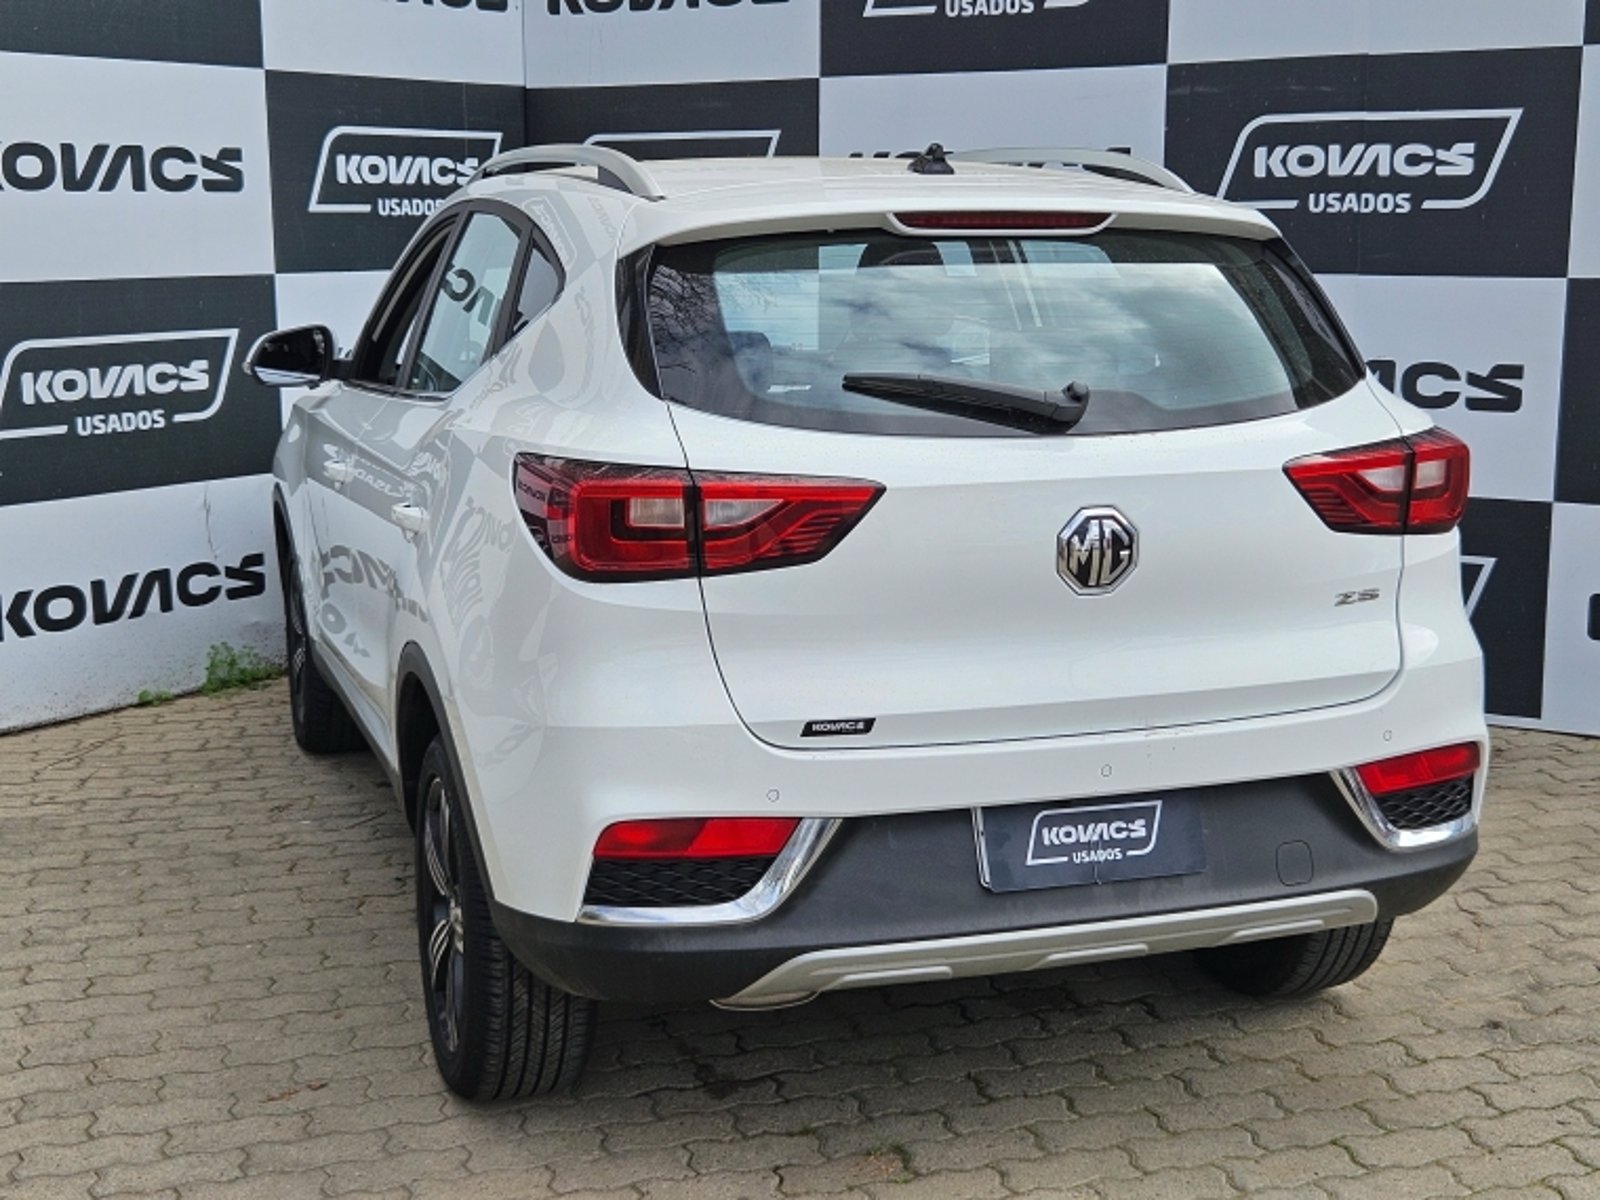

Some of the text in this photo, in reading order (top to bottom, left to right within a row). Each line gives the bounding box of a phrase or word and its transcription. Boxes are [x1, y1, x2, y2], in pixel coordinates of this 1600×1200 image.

[0, 141, 244, 192] OVACS
[336, 154, 479, 187] KOVACS
[1254, 143, 1475, 178] KOVACS
[1308, 192, 1411, 213] USADOS
[20, 359, 209, 404] KOVACS
[76, 410, 165, 436] USADOS
[1068, 517, 1132, 587] MG
[0, 553, 265, 642] KOVACS
[1042, 818, 1146, 846] KOVACS
[1072, 848, 1123, 864] USADOS
